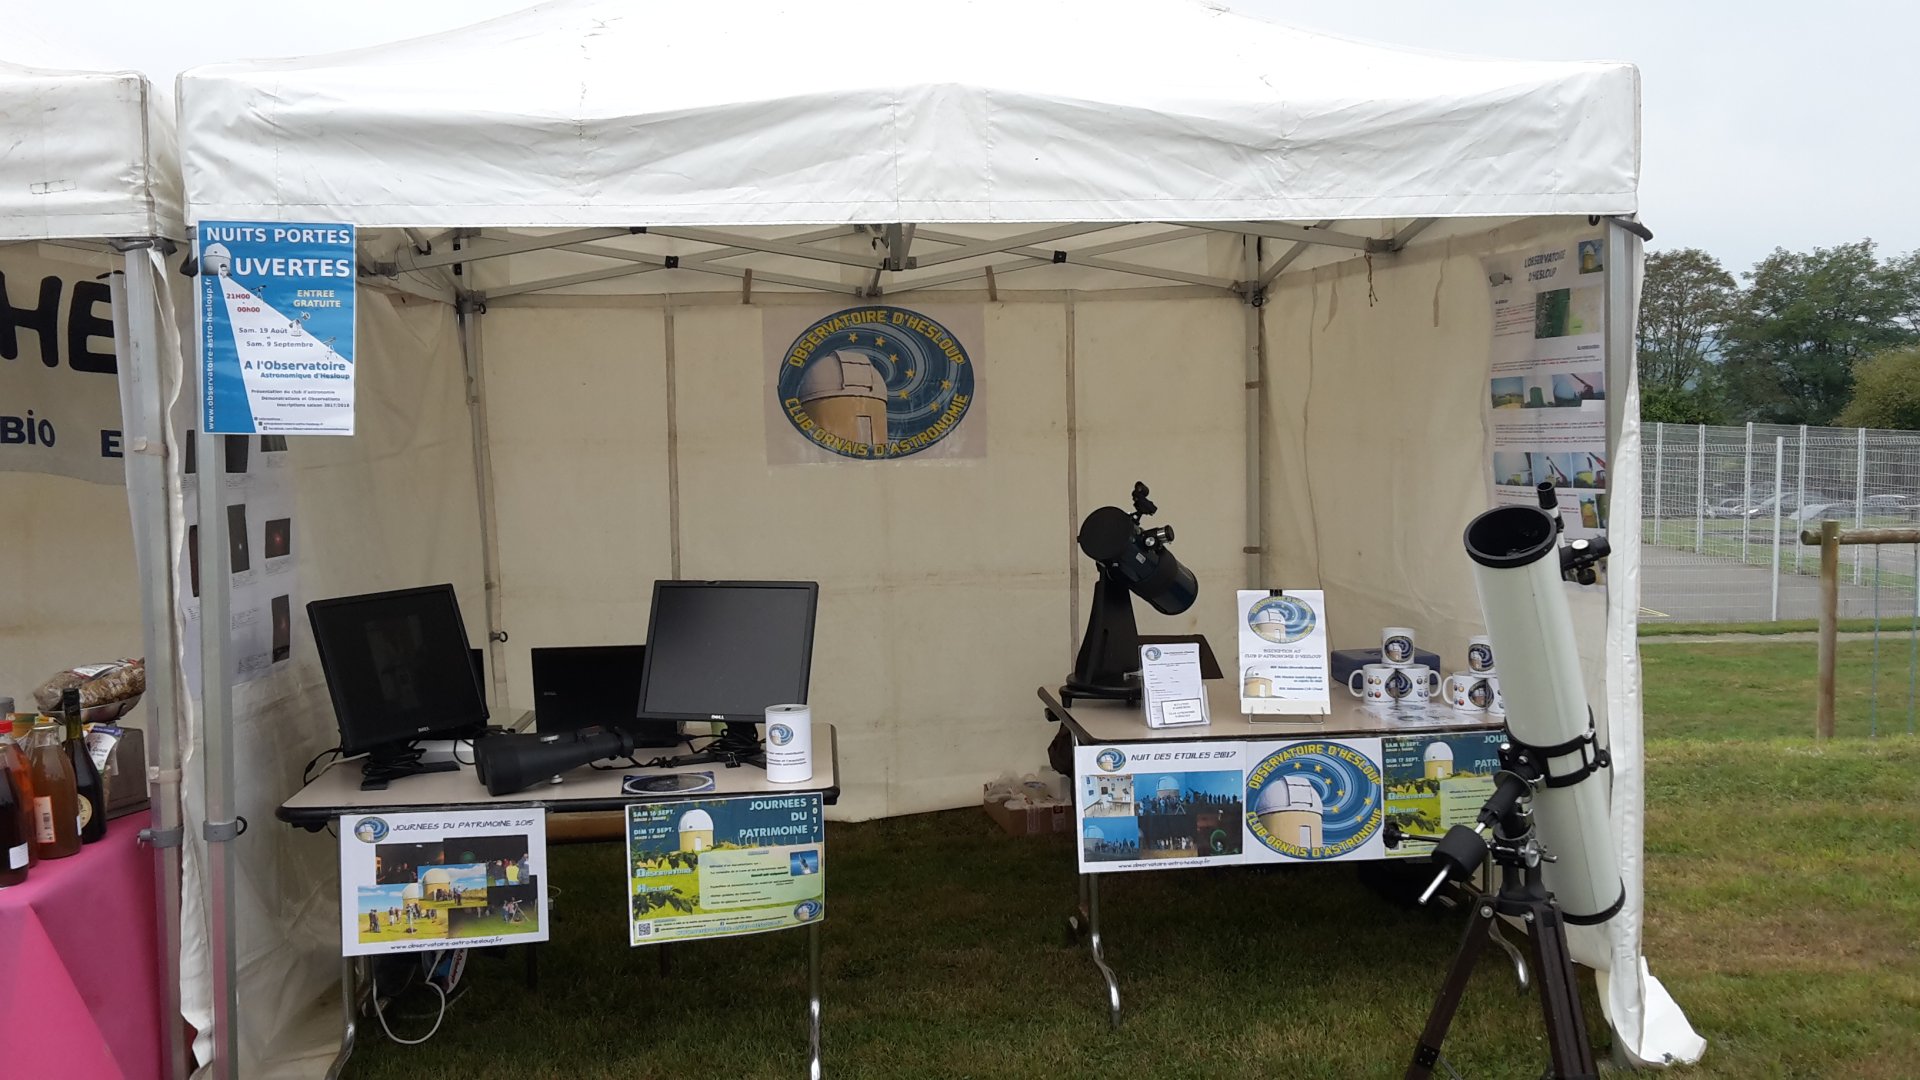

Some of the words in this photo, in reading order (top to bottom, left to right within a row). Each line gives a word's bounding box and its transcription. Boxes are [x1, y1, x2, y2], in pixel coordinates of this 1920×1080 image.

[206, 227, 267, 242] NUITS
[274, 228, 350, 244] PORTES
[235, 258, 350, 277] UVERTES
[293, 299, 341, 308] GRATUITE
[788, 310, 888, 368] OBSERVATOIRE
[892, 311, 966, 365] D'HESLOUP
[206, 278, 214, 430] www.observatoire-astro-hesloup.fr
[244, 361, 252, 370] A
[257, 360, 346, 370] l'Observatoire
[784, 396, 815, 432] CLUB
[813, 426, 870, 456] ORNAIS
[874, 394, 969, 457] D'ASTRONOMIE
[1174, 752, 1210, 760] ETOILES
[1248, 744, 1325, 790] OBSERVATOIRE
[1328, 744, 1381, 785] D'HESLOUP
[750, 798, 807, 811] JOURNEES
[791, 812, 808, 822] DU
[393, 823, 439, 831] JOURNEES
[458, 820, 511, 828] PATRIMOINE
[739, 825, 808, 839] PATRIMOINE
[1246, 812, 1266, 838] CLUB
[1266, 836, 1307, 857] ORNAIS
[1312, 808, 1382, 857] D'ASTRONOMIE
